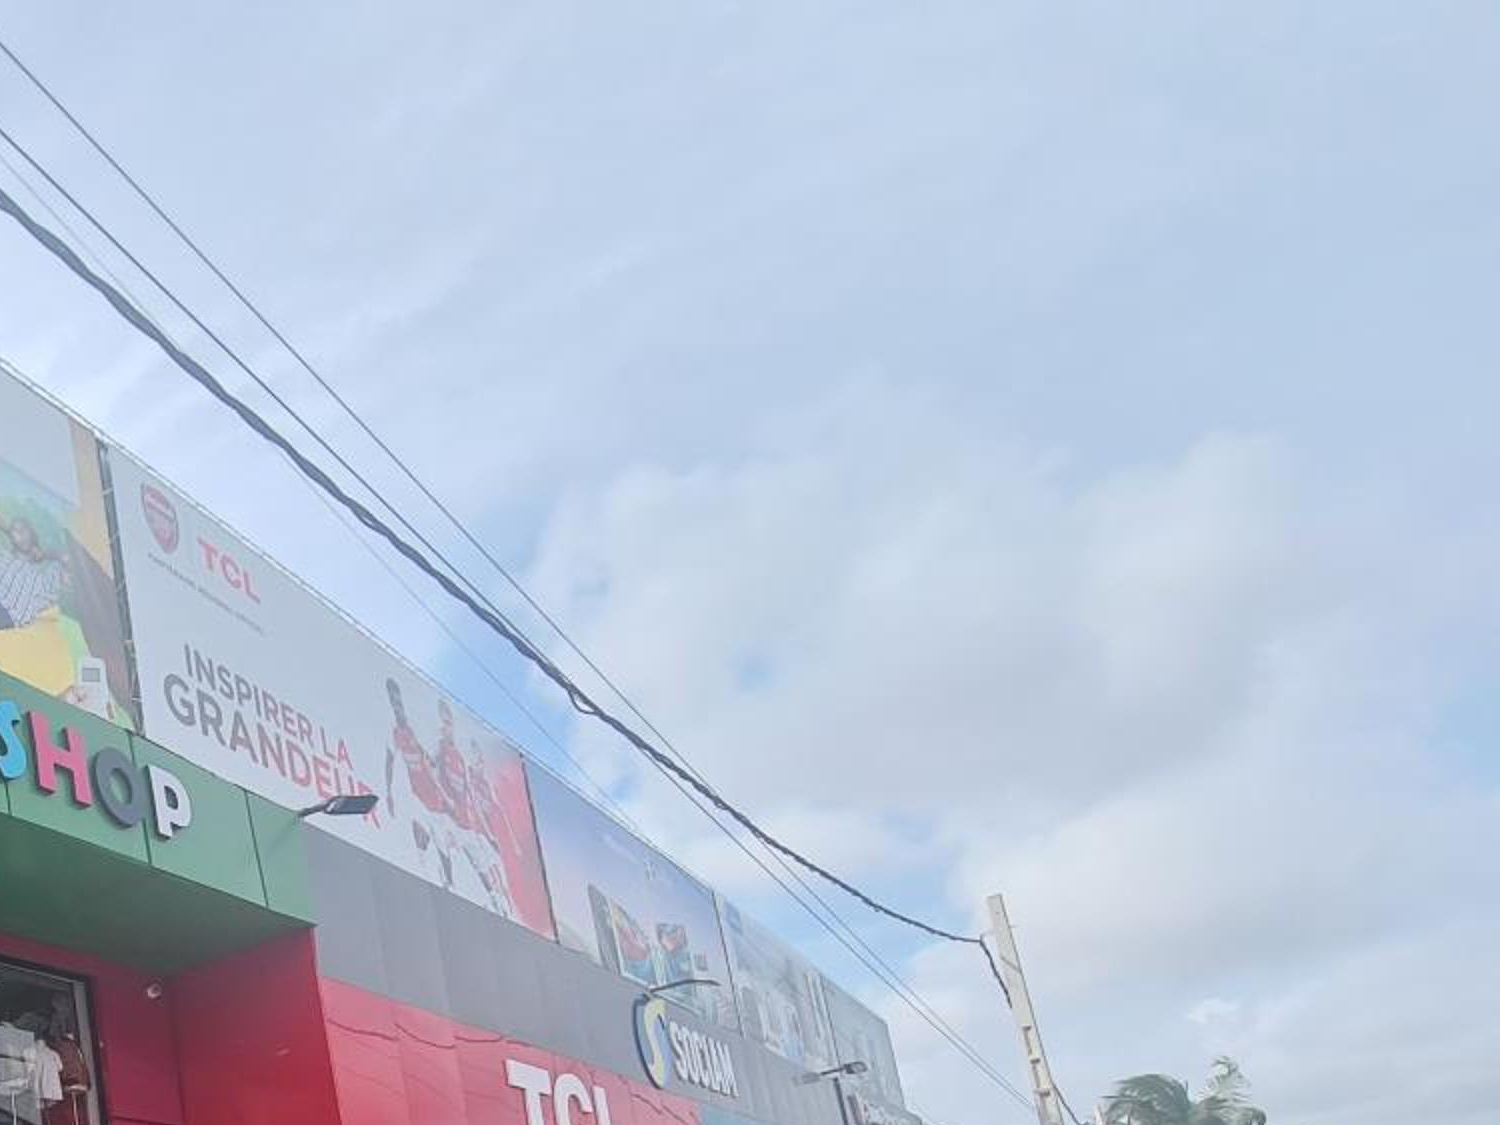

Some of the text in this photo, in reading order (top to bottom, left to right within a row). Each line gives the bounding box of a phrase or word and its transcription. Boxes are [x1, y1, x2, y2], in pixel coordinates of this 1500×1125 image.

[197, 535, 260, 605] TCL
[184, 643, 353, 770] INSPIRER LA
